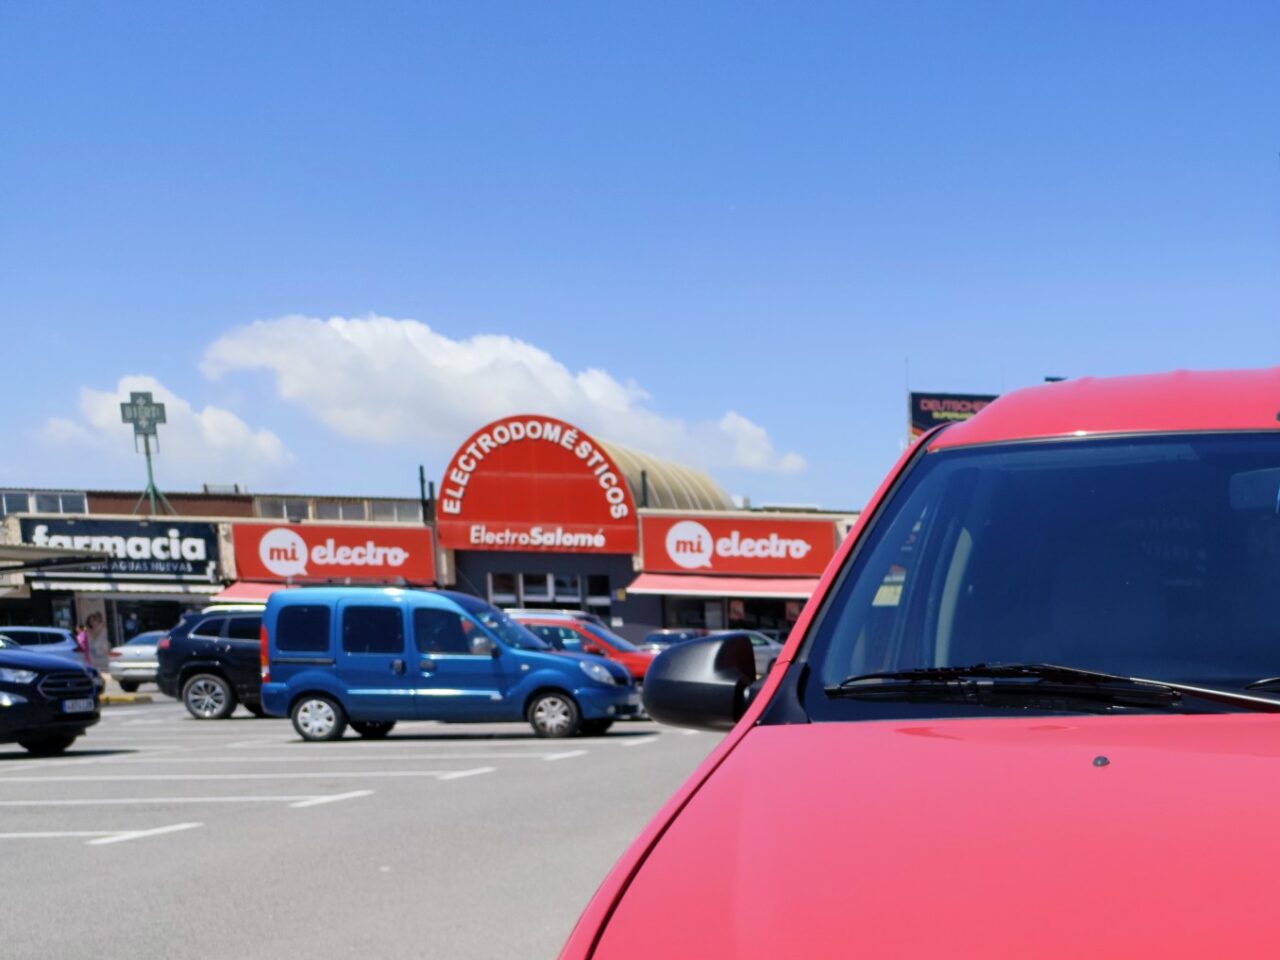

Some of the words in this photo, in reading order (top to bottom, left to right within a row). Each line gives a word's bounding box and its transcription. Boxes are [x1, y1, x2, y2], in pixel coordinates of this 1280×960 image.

[442, 420, 629, 519] ELECTRODOMÉSTICOS
[33, 525, 206, 560] farmacia
[269, 542, 299, 562] mi
[311, 538, 409, 567] electro
[675, 534, 704, 554] mi
[716, 530, 812, 559] electro
